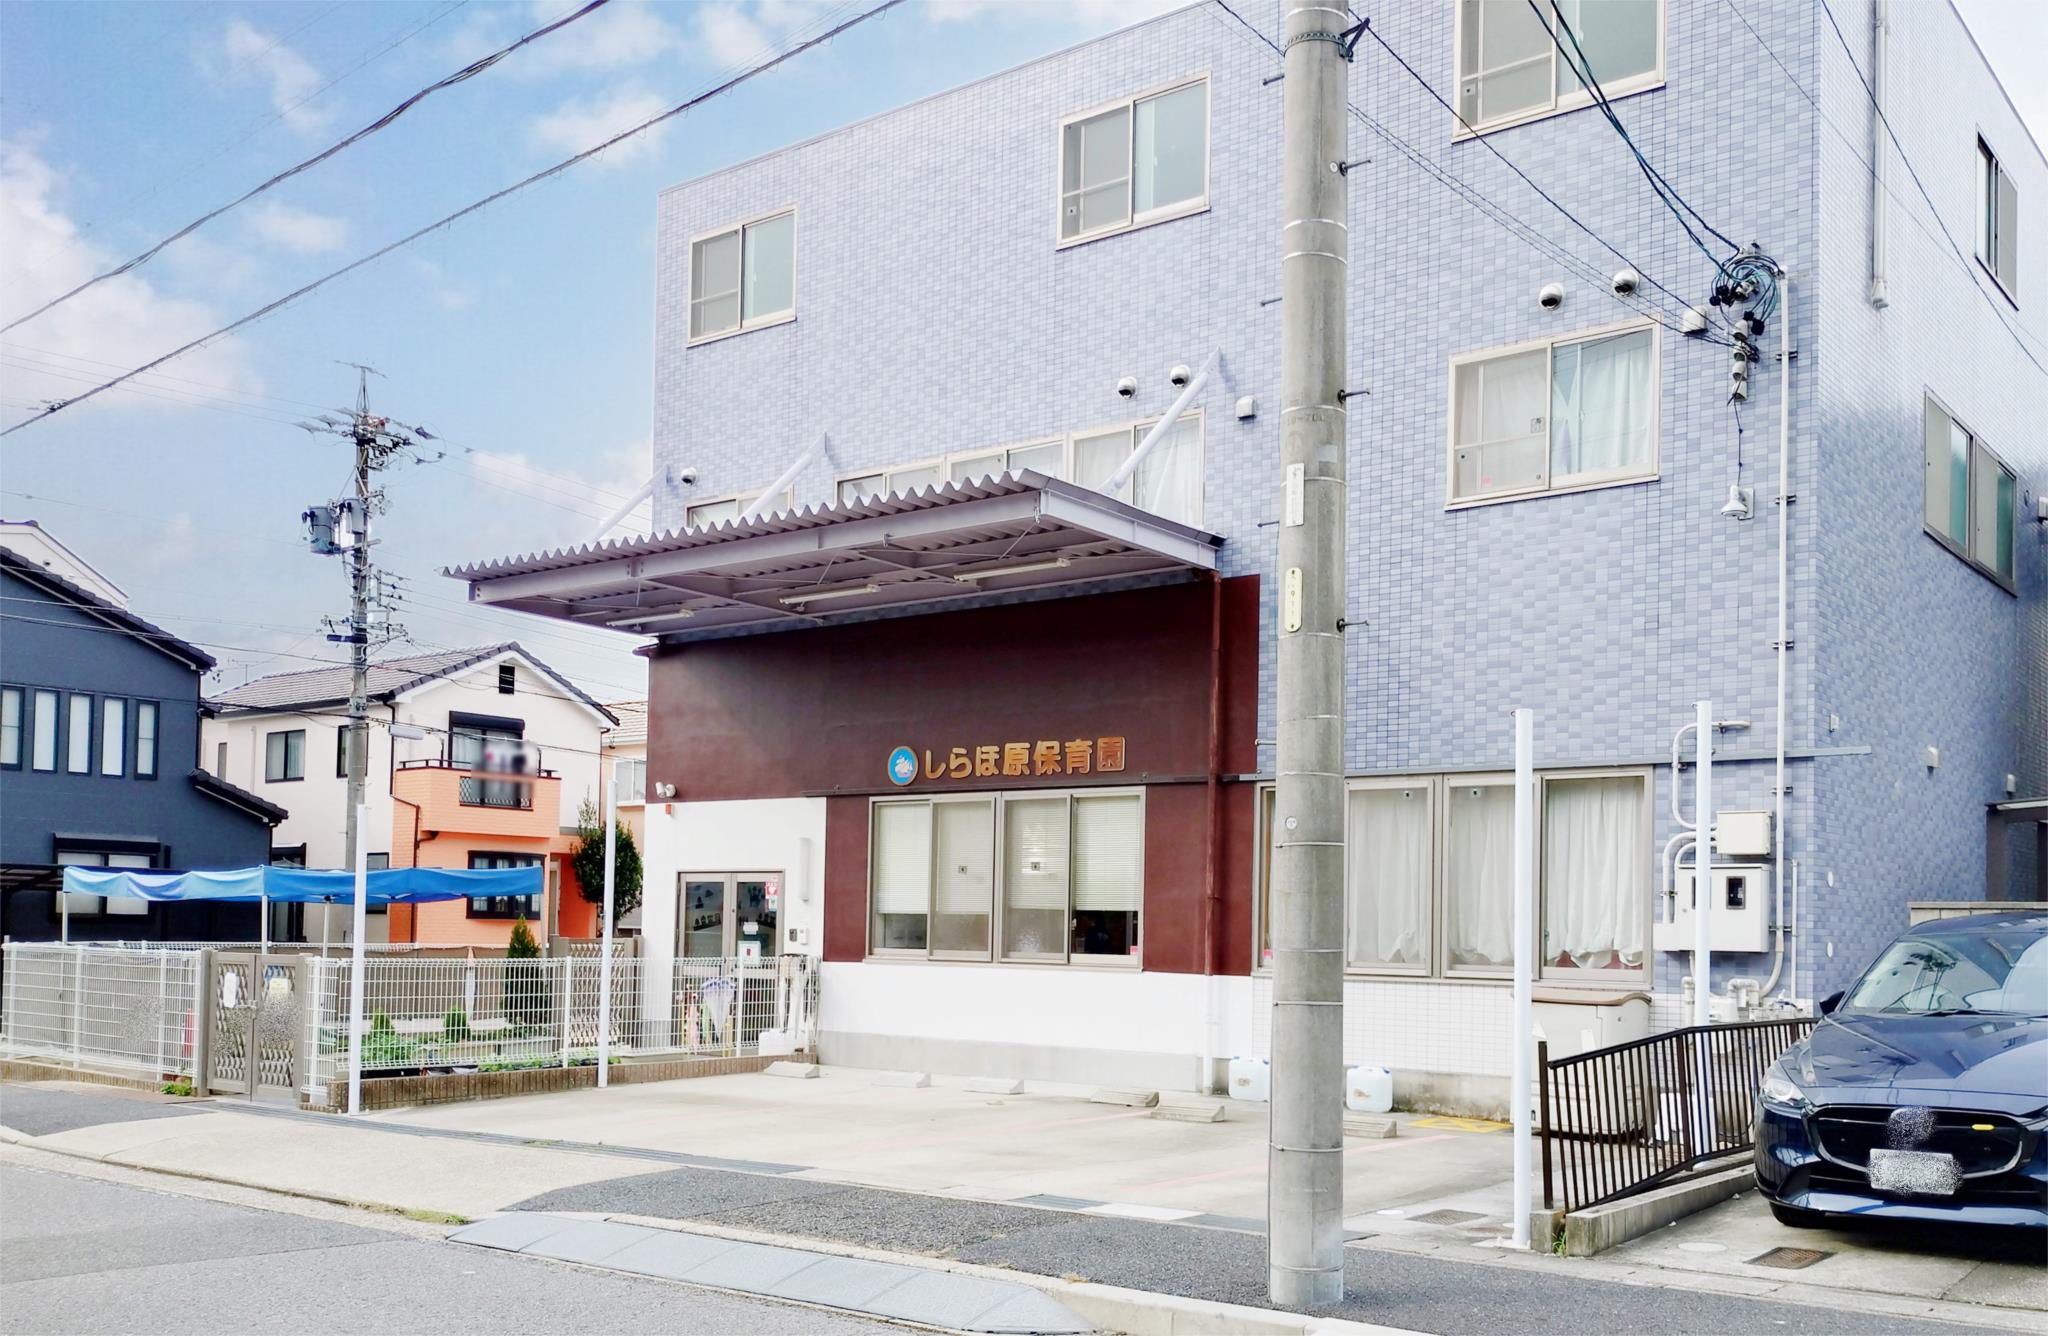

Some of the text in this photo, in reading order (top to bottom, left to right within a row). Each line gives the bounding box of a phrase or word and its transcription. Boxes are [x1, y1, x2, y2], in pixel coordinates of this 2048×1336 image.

[925, 736, 1126, 780] しらほ原保育園
